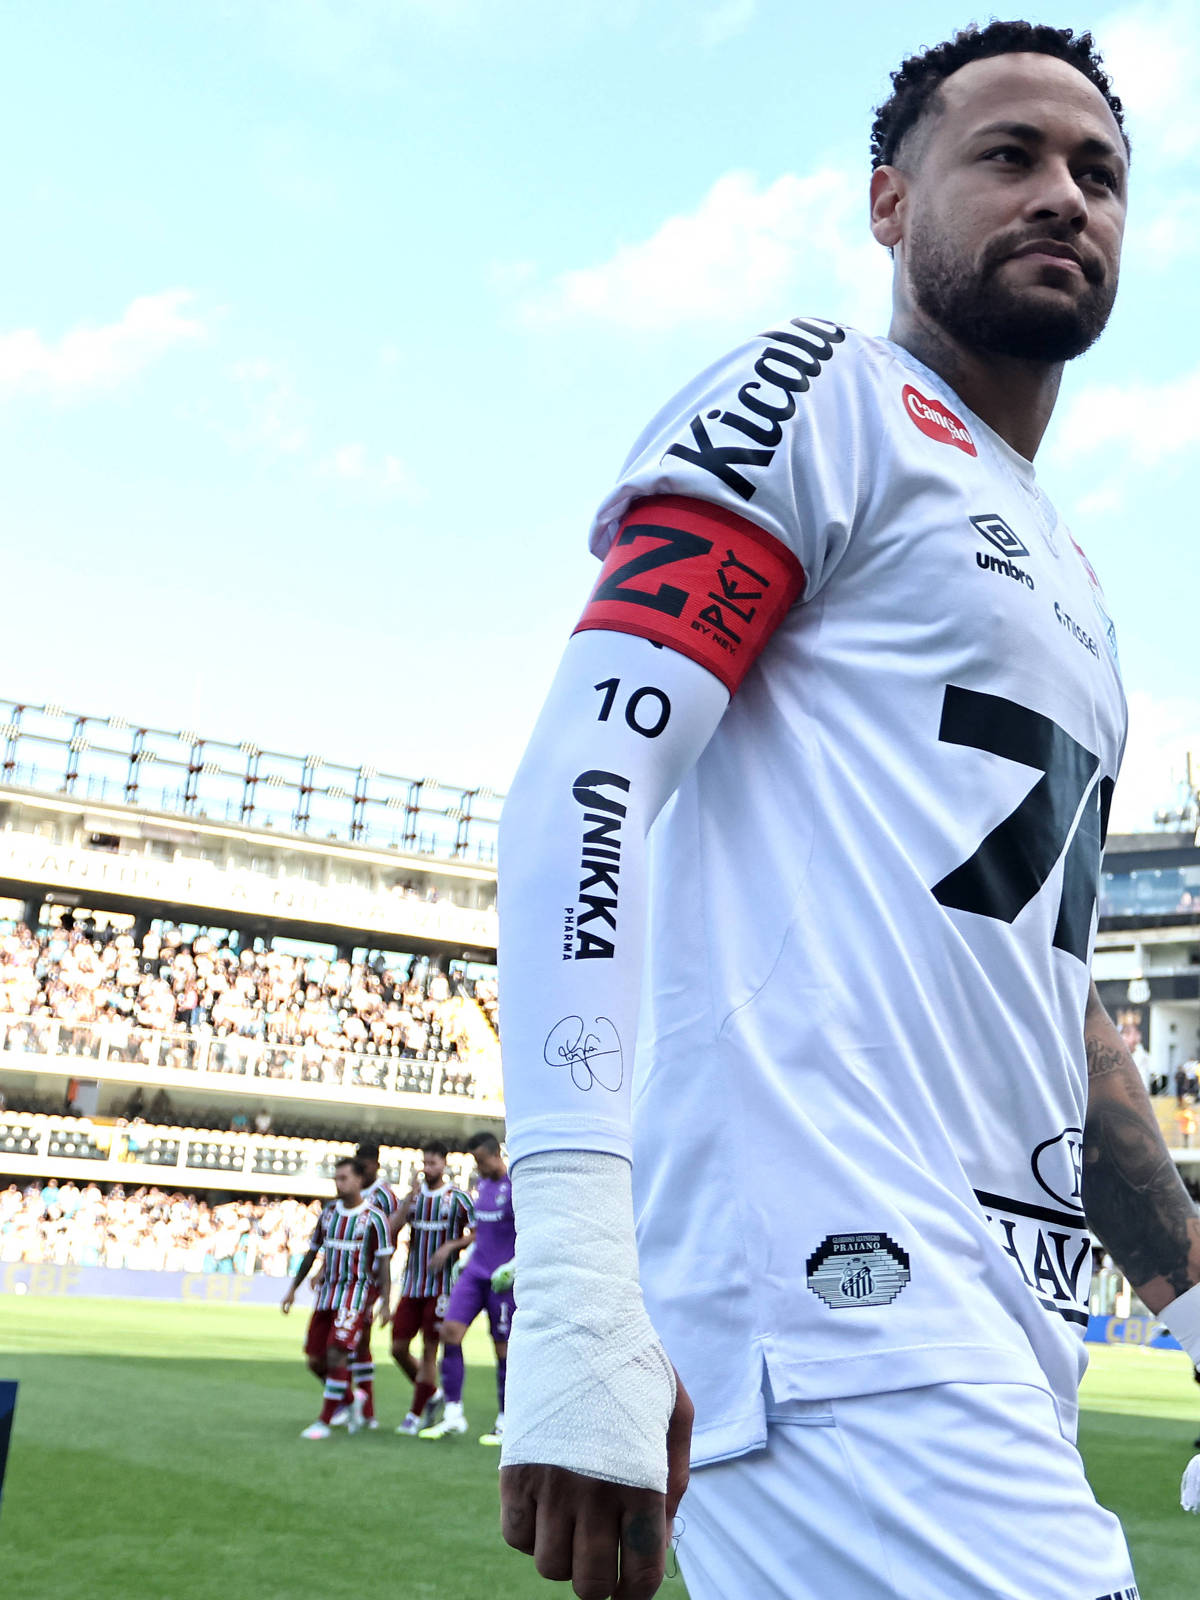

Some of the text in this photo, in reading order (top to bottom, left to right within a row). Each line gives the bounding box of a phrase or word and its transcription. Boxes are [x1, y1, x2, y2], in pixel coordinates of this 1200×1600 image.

[908, 394, 973, 444] Canção
[976, 552, 1034, 590] umbro
[594, 678, 671, 738] 10
[572, 769, 631, 961] UNIKKA
[562, 907, 574, 961] PHARMA
[833, 1242, 880, 1252] PRAIANO
